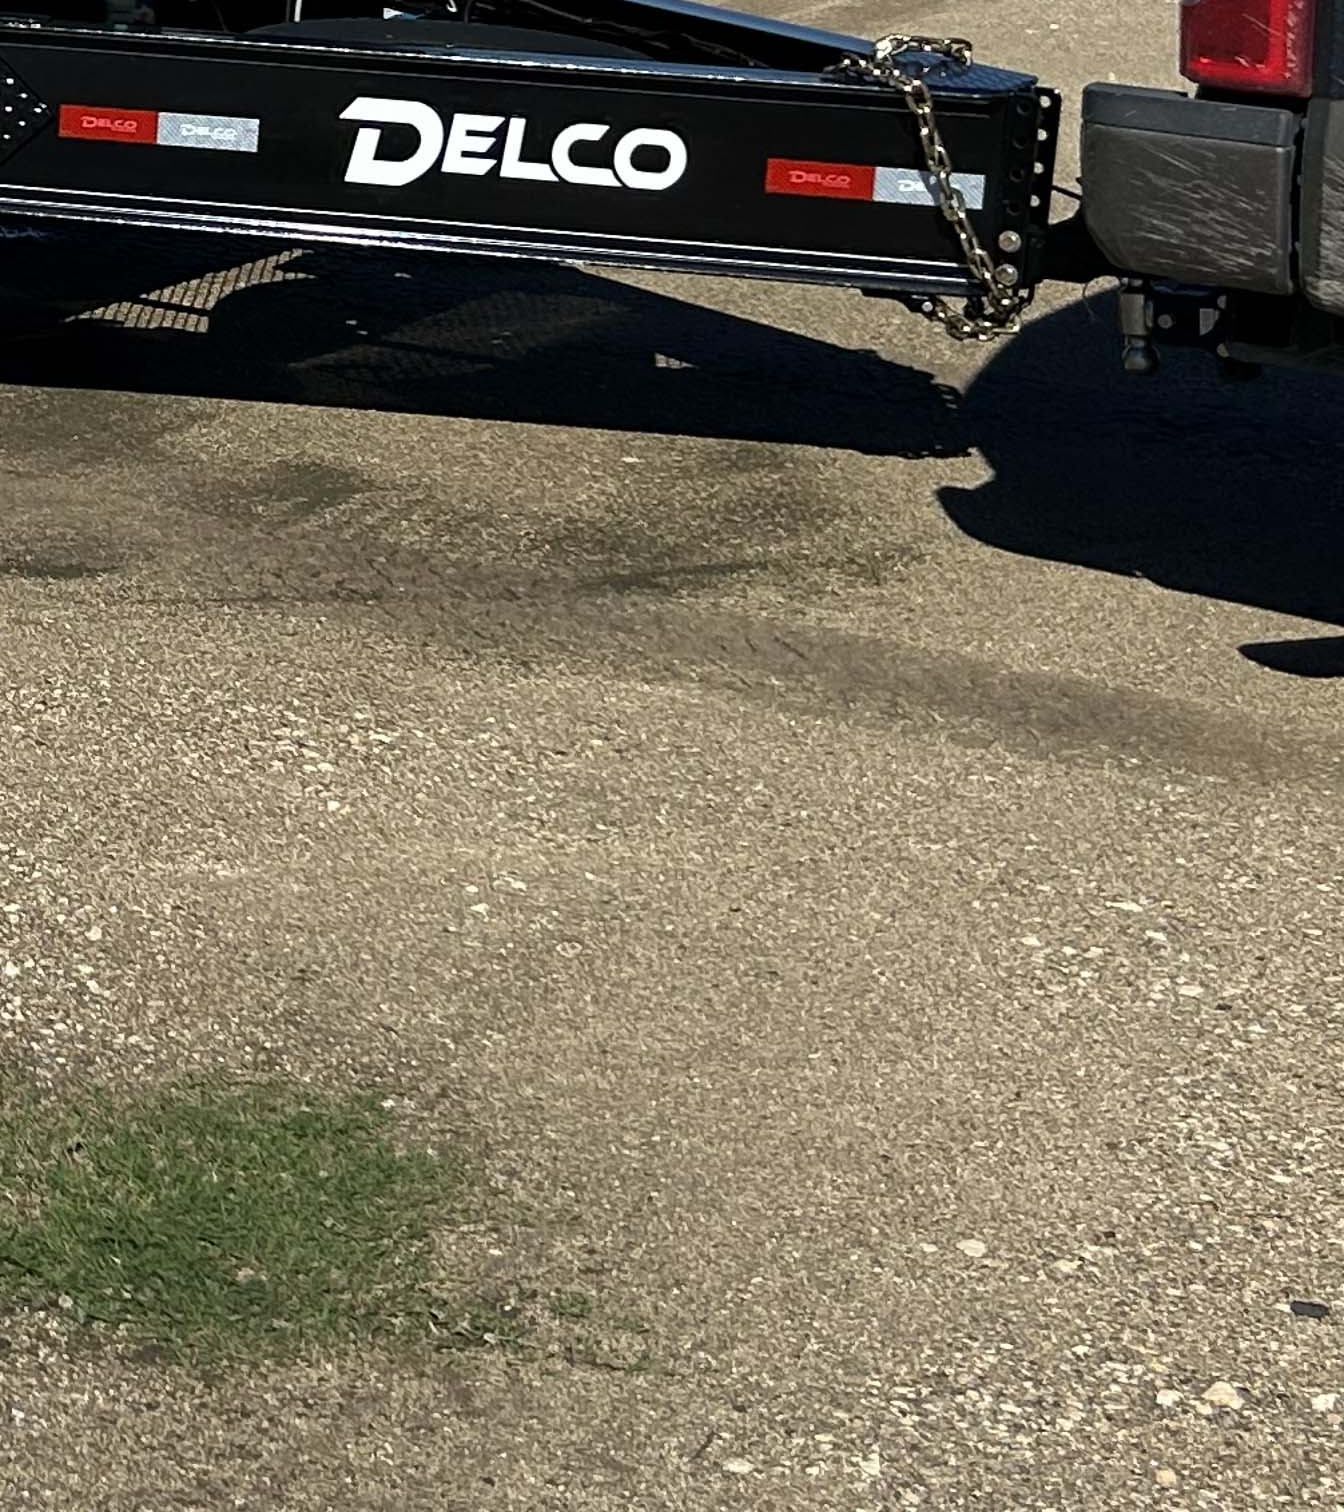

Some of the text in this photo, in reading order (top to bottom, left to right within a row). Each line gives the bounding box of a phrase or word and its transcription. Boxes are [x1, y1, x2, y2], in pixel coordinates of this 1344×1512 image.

[80, 115, 138, 130] DELCO
[179, 123, 238, 139] DELCO
[338, 96, 688, 191] DELCO
[787, 170, 852, 186] DELCO
